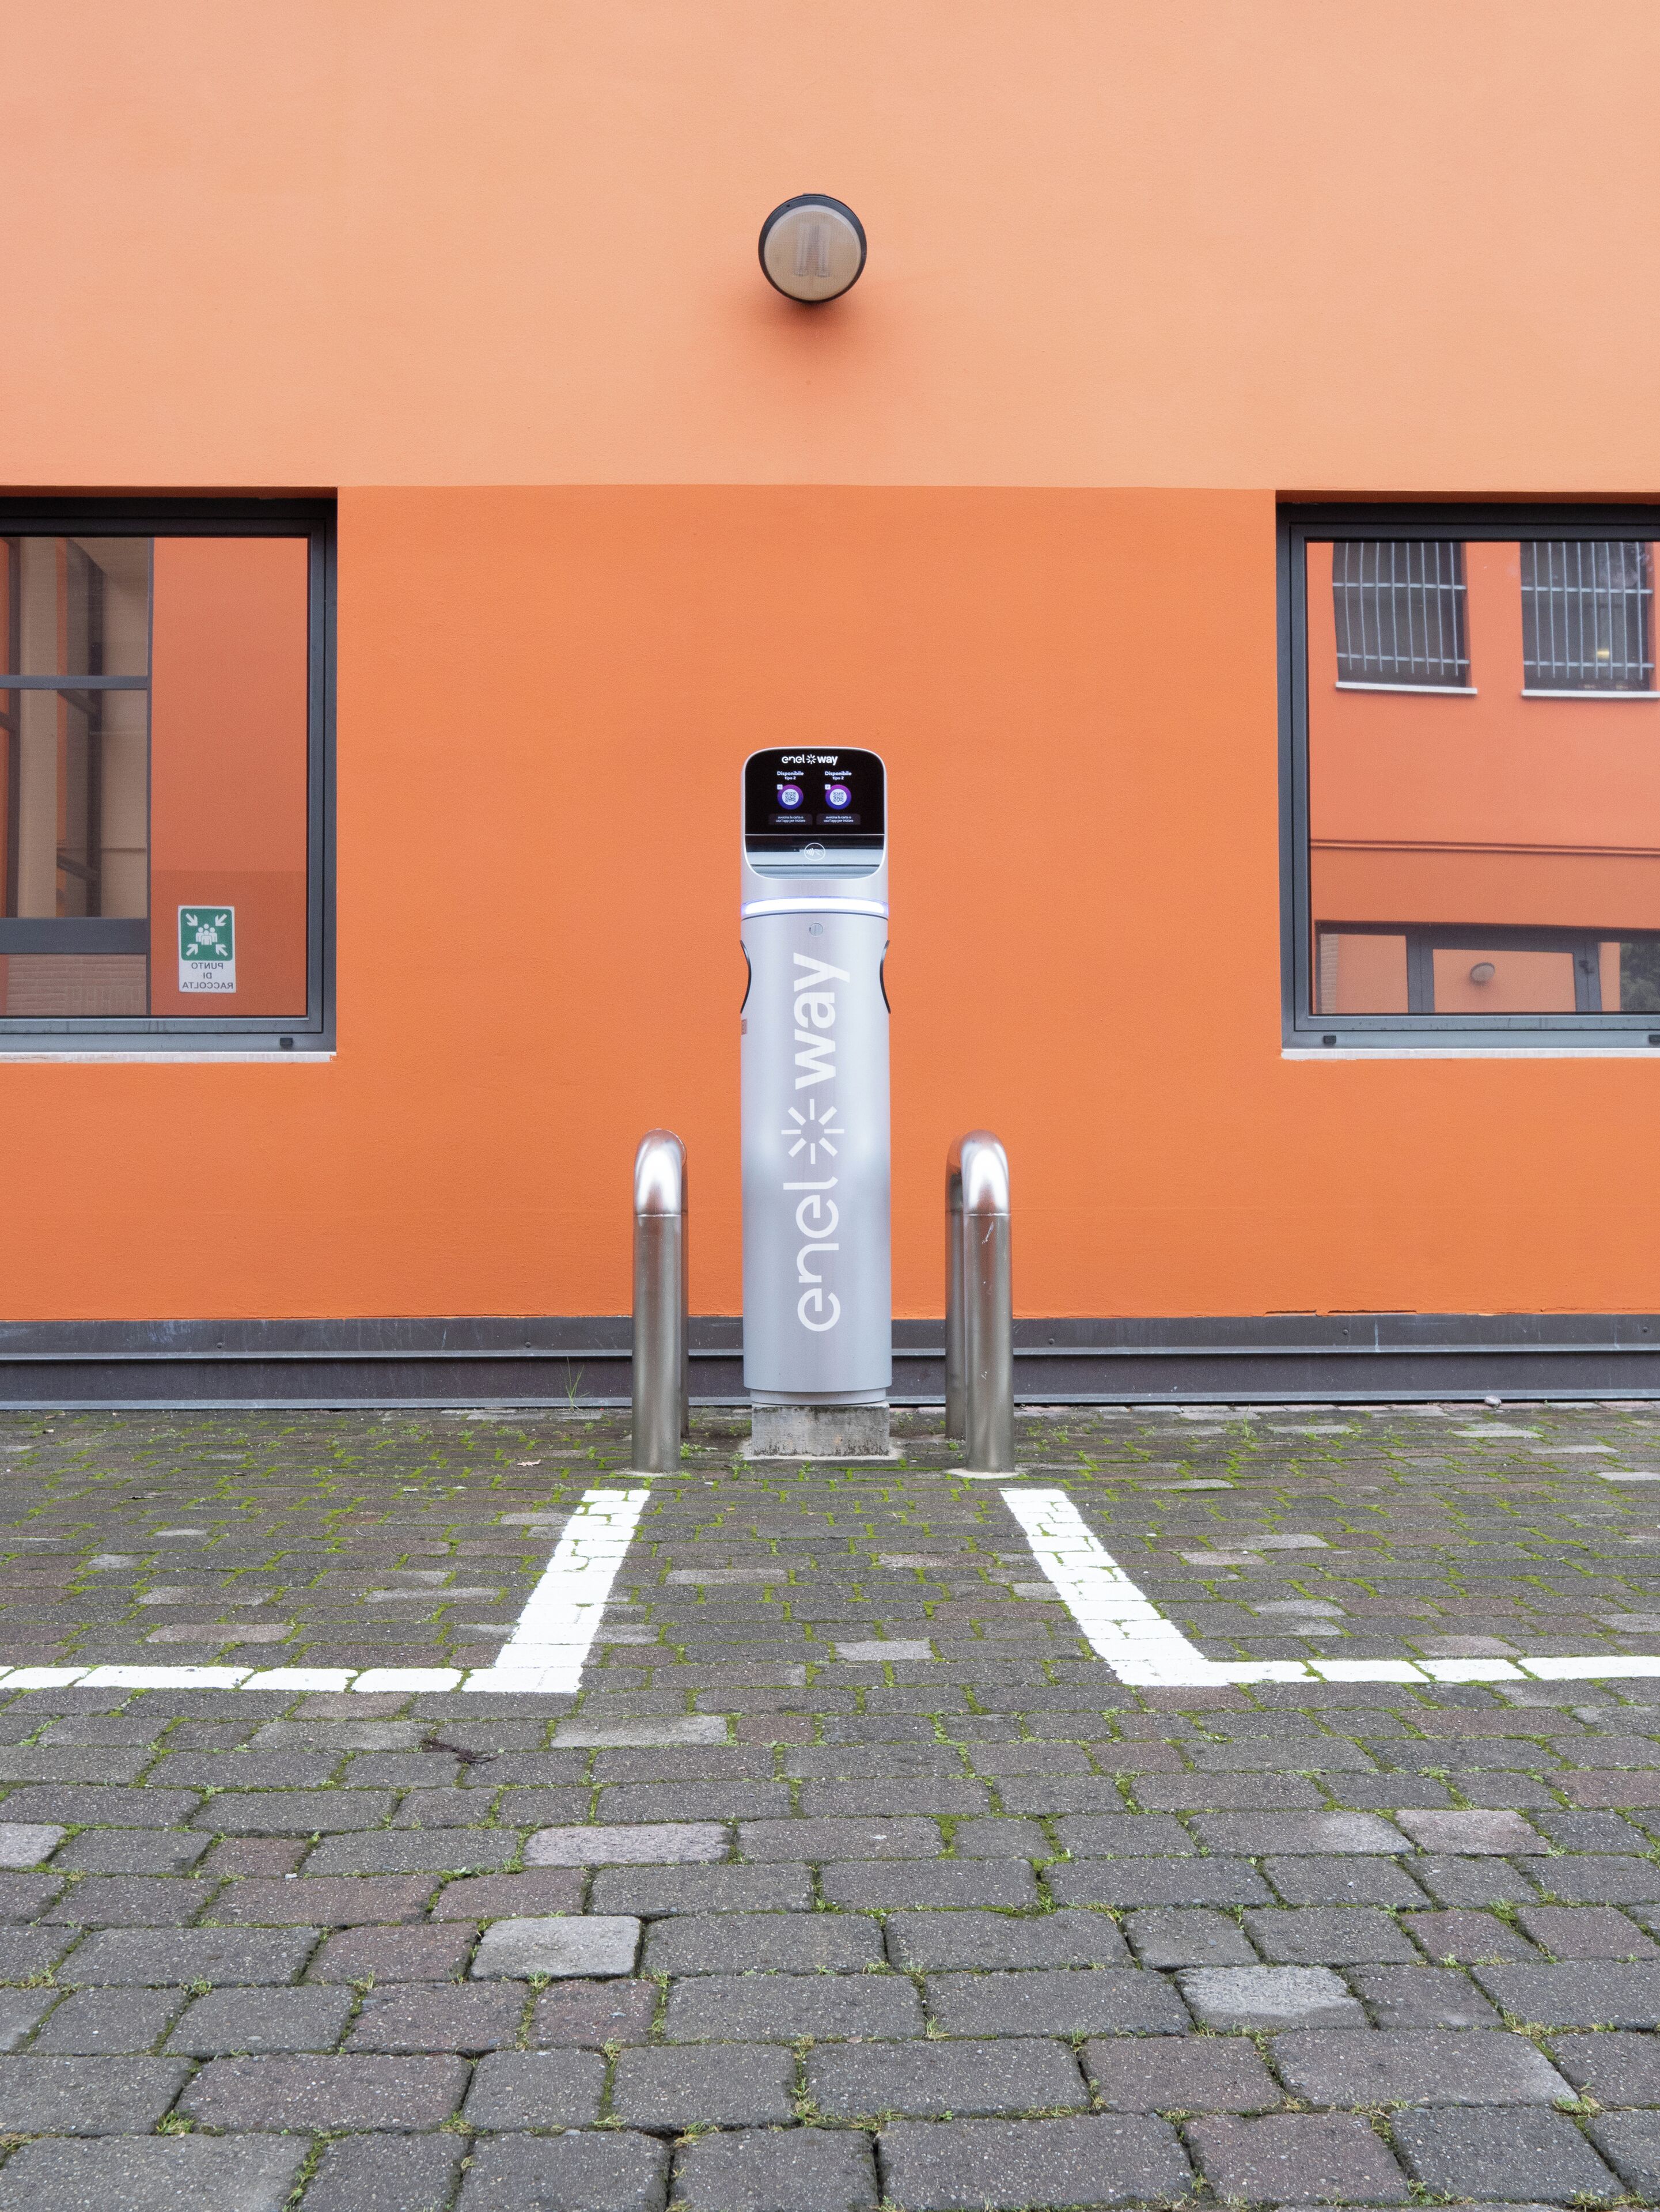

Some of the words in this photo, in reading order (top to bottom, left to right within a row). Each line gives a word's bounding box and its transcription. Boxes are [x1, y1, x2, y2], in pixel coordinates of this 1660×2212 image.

[782, 754, 805, 764] enel
[817, 756, 838, 766] way
[793, 952, 850, 1090] way
[783, 1176, 841, 1332] enel
